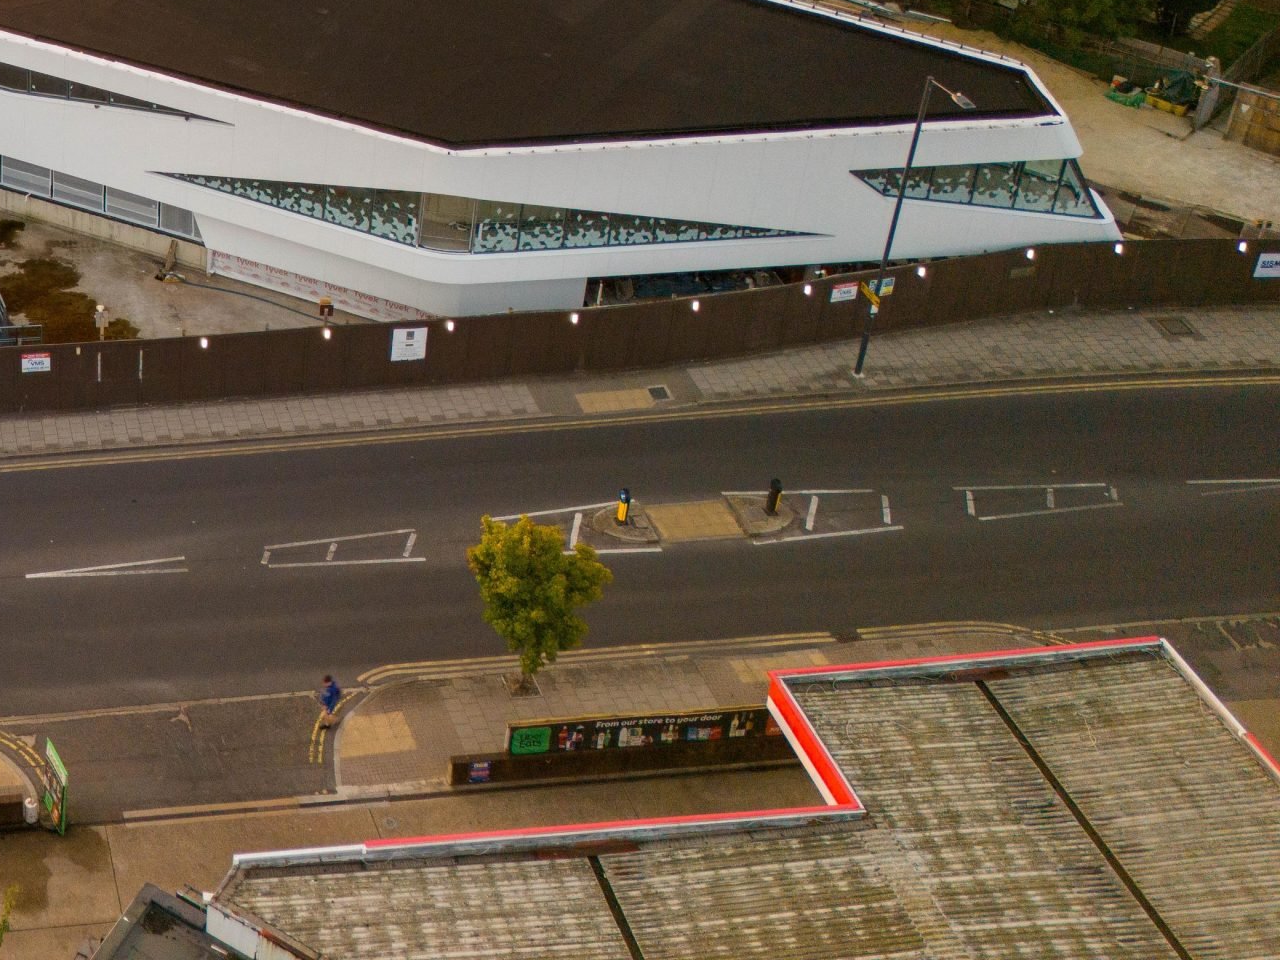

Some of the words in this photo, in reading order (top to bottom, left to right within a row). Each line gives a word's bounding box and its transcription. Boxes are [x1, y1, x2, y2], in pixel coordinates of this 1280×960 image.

[236, 257, 259, 268] Tyvek
[265, 265, 288, 276] Tyvek
[295, 273, 319, 285] Tyvek
[324, 282, 348, 294] Tyvek
[354, 290, 378, 303] Tyvek
[385, 300, 409, 312] Tyvek
[638, 717, 664, 725] store
[677, 716, 699, 724] your
[520, 740, 542, 748] Eats
